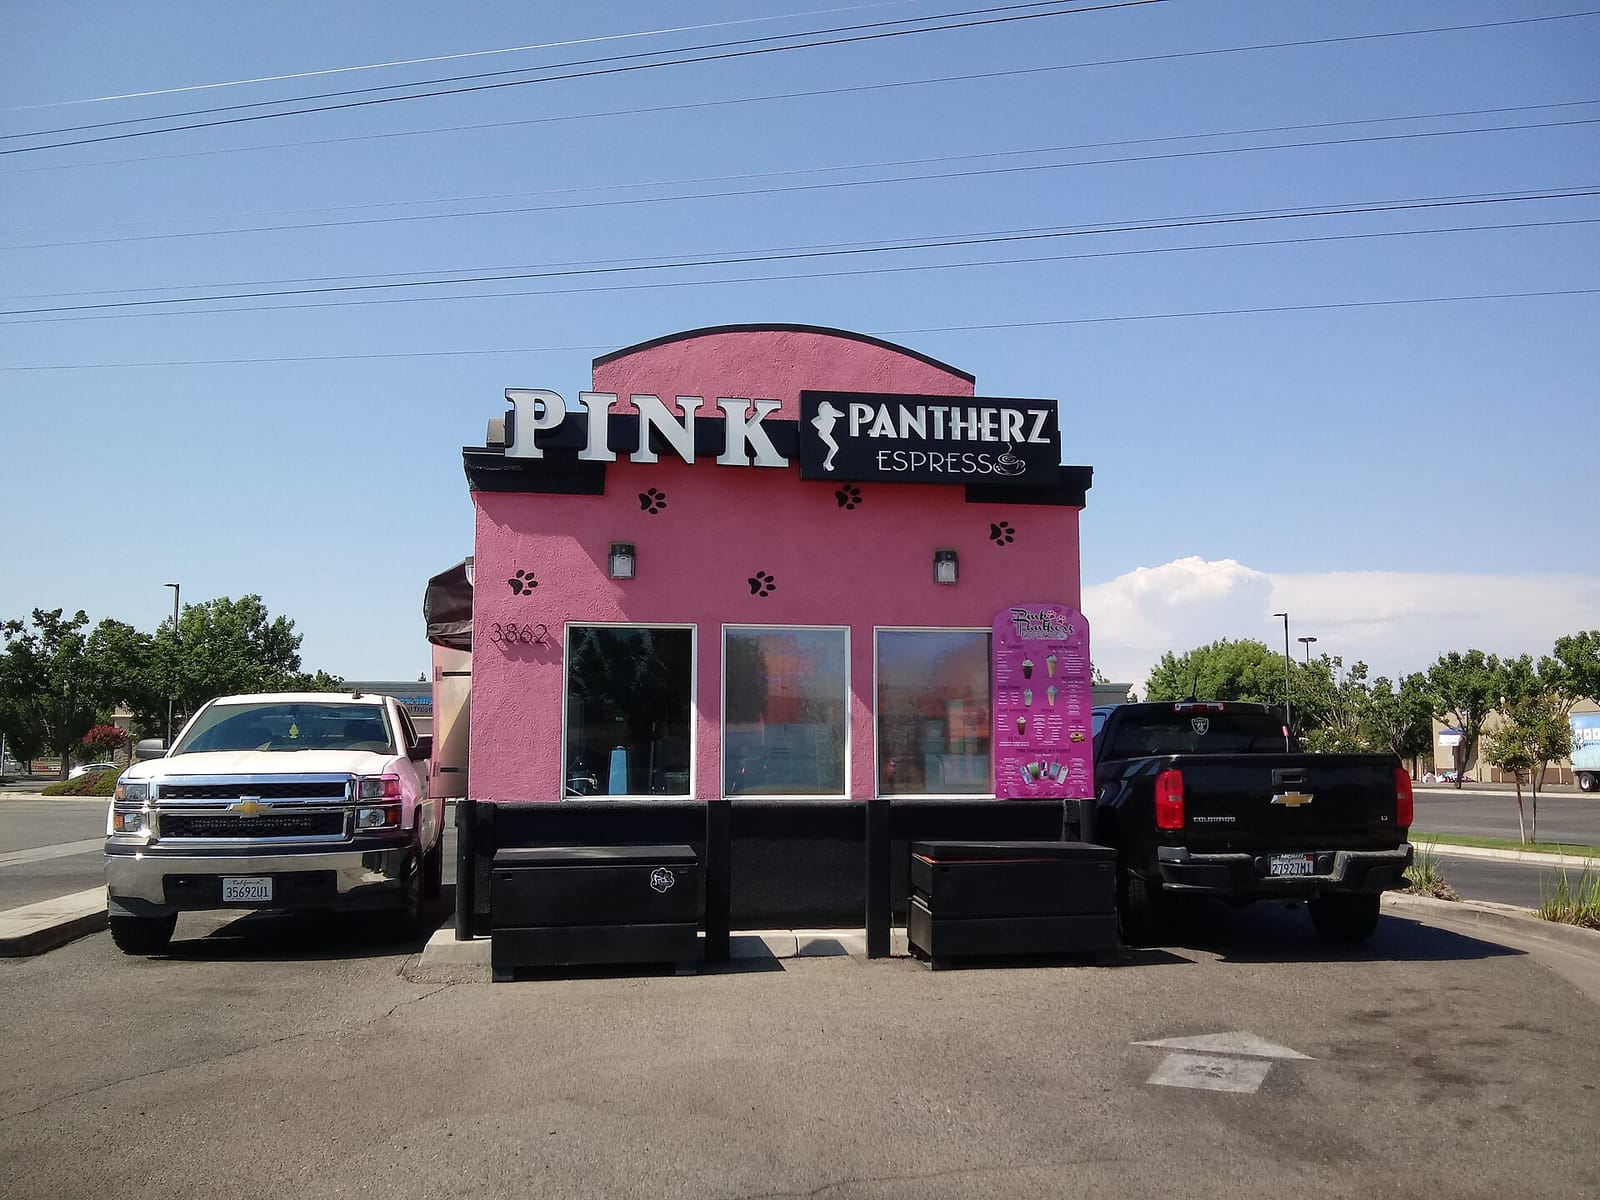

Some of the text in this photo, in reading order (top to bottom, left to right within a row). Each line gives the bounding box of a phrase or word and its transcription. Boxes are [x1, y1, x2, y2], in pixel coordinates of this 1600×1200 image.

[504, 388, 790, 467] PINK
[850, 402, 1051, 443] PANTHERZ
[489, 622, 548, 643] 3862
[226, 886, 269, 897] 35692U1
